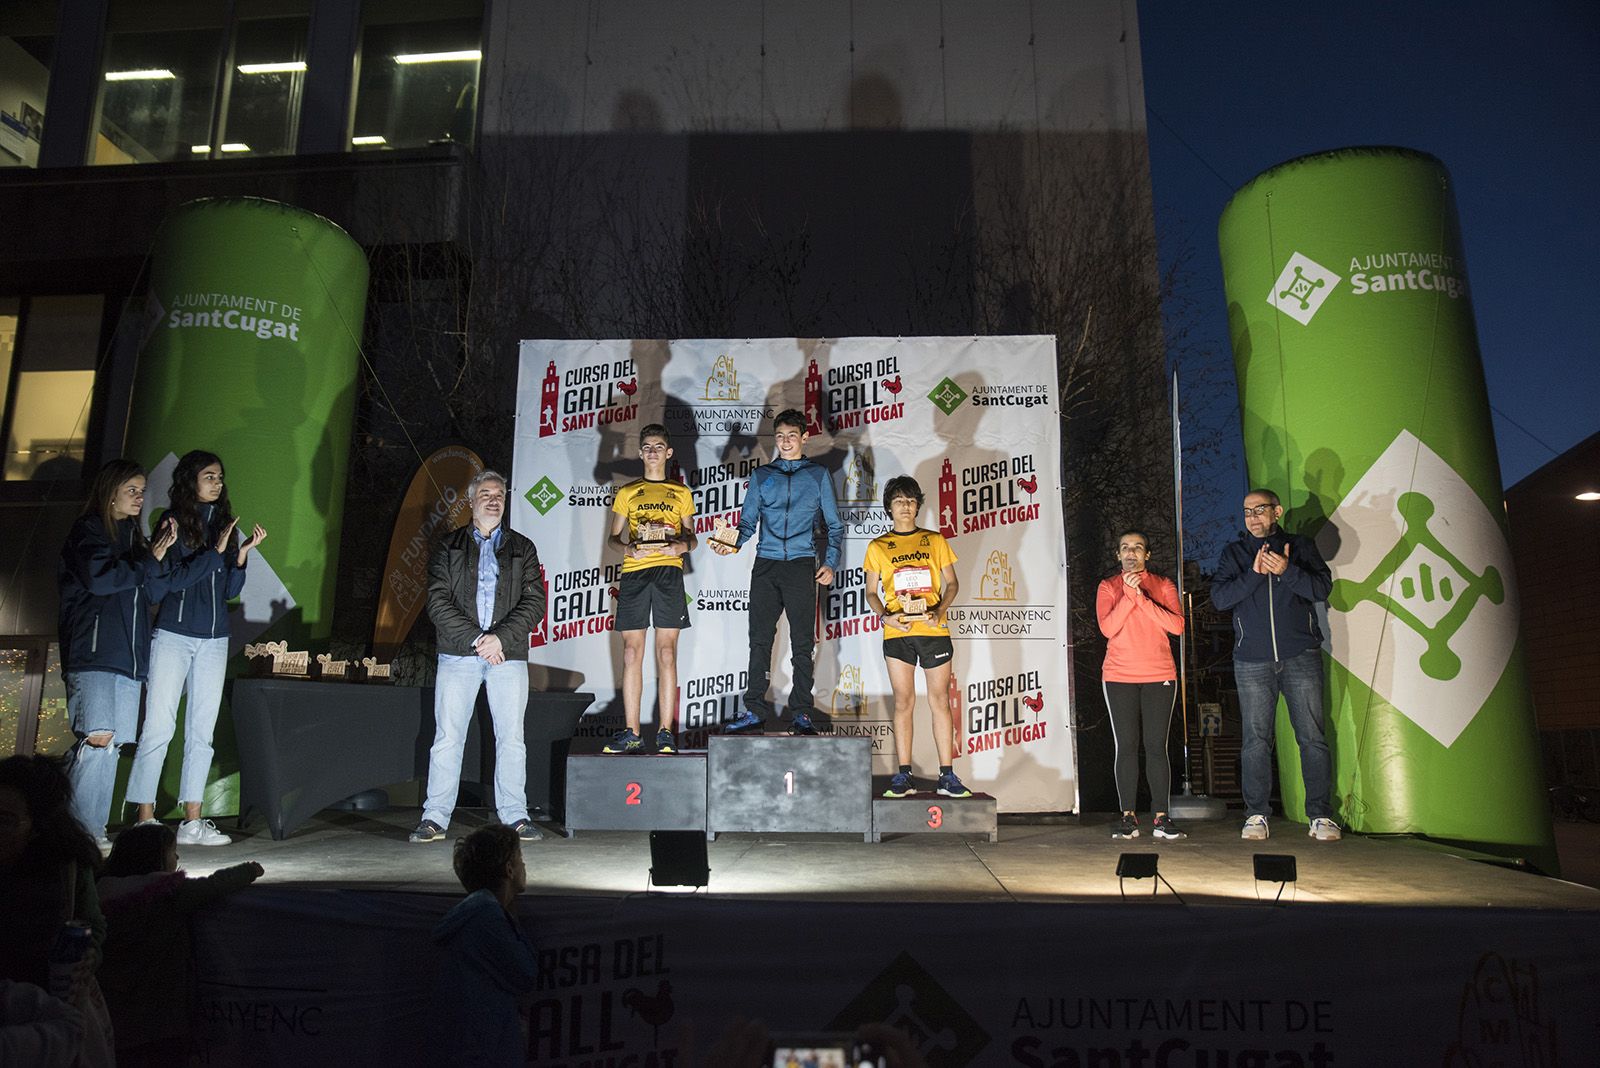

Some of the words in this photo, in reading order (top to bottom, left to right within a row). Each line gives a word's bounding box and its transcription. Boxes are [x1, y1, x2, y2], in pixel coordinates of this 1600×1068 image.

[172, 293, 278, 314] AJUNTAMENT
[281, 304, 302, 321] DE
[168, 309, 300, 341] SantCugat
[565, 363, 610, 387] CURSA
[613, 358, 636, 379] DEL
[828, 362, 871, 386] CURSA
[877, 356, 900, 375] DEL
[563, 385, 618, 414] GALL
[828, 381, 883, 413] GALL
[972, 385, 1033, 394] AJUNTAMENT
[1036, 385, 1047, 393] DE
[972, 394, 1049, 408] SantCugat
[561, 411, 596, 433] SANT
[597, 404, 638, 426] CUGAT
[665, 409, 691, 420] CLUB
[693, 409, 774, 420] MUNTANYENC
[683, 422, 711, 432] SANT
[716, 422, 754, 432] CUGAT
[828, 410, 860, 432] SANT
[864, 402, 904, 425] CUGAT
[690, 462, 734, 487] CURSA
[962, 461, 1007, 486] CURSA
[1012, 454, 1035, 474] DEL
[568, 495, 615, 507] SantC
[569, 486, 622, 494] AJUNTAME
[692, 482, 743, 516] GALL
[962, 479, 1019, 515] GALL
[695, 513, 722, 534] ANT
[854, 524, 893, 535] CUGAT
[963, 511, 996, 534] SANT
[1000, 503, 1040, 524] CUGAT
[554, 568, 600, 592] CURSA
[553, 589, 608, 622] GALL
[827, 588, 870, 620] GAL
[946, 611, 966, 621] LUB
[969, 610, 1051, 622] MUNTANYENC
[553, 620, 585, 642] SANT
[826, 619, 860, 640] SANT
[959, 625, 989, 634] SANT
[992, 624, 1032, 634] CUGAT
[687, 674, 734, 699] CURSA
[968, 676, 1013, 702] CURSA
[1018, 670, 1041, 691] DEL
[968, 698, 1025, 733] GALL
[967, 730, 1001, 754] SANT
[1004, 722, 1047, 744] CUGAT
[626, 783, 641, 805] 2
[784, 770, 794, 794] 1
[927, 806, 943, 828] 3
[537, 943, 601, 991] RSA
[613, 934, 670, 980] DEL
[528, 991, 625, 1062] ALL
[1012, 998, 1271, 1031] AJUNTAMENT
[1286, 1001, 1334, 1032] DE
